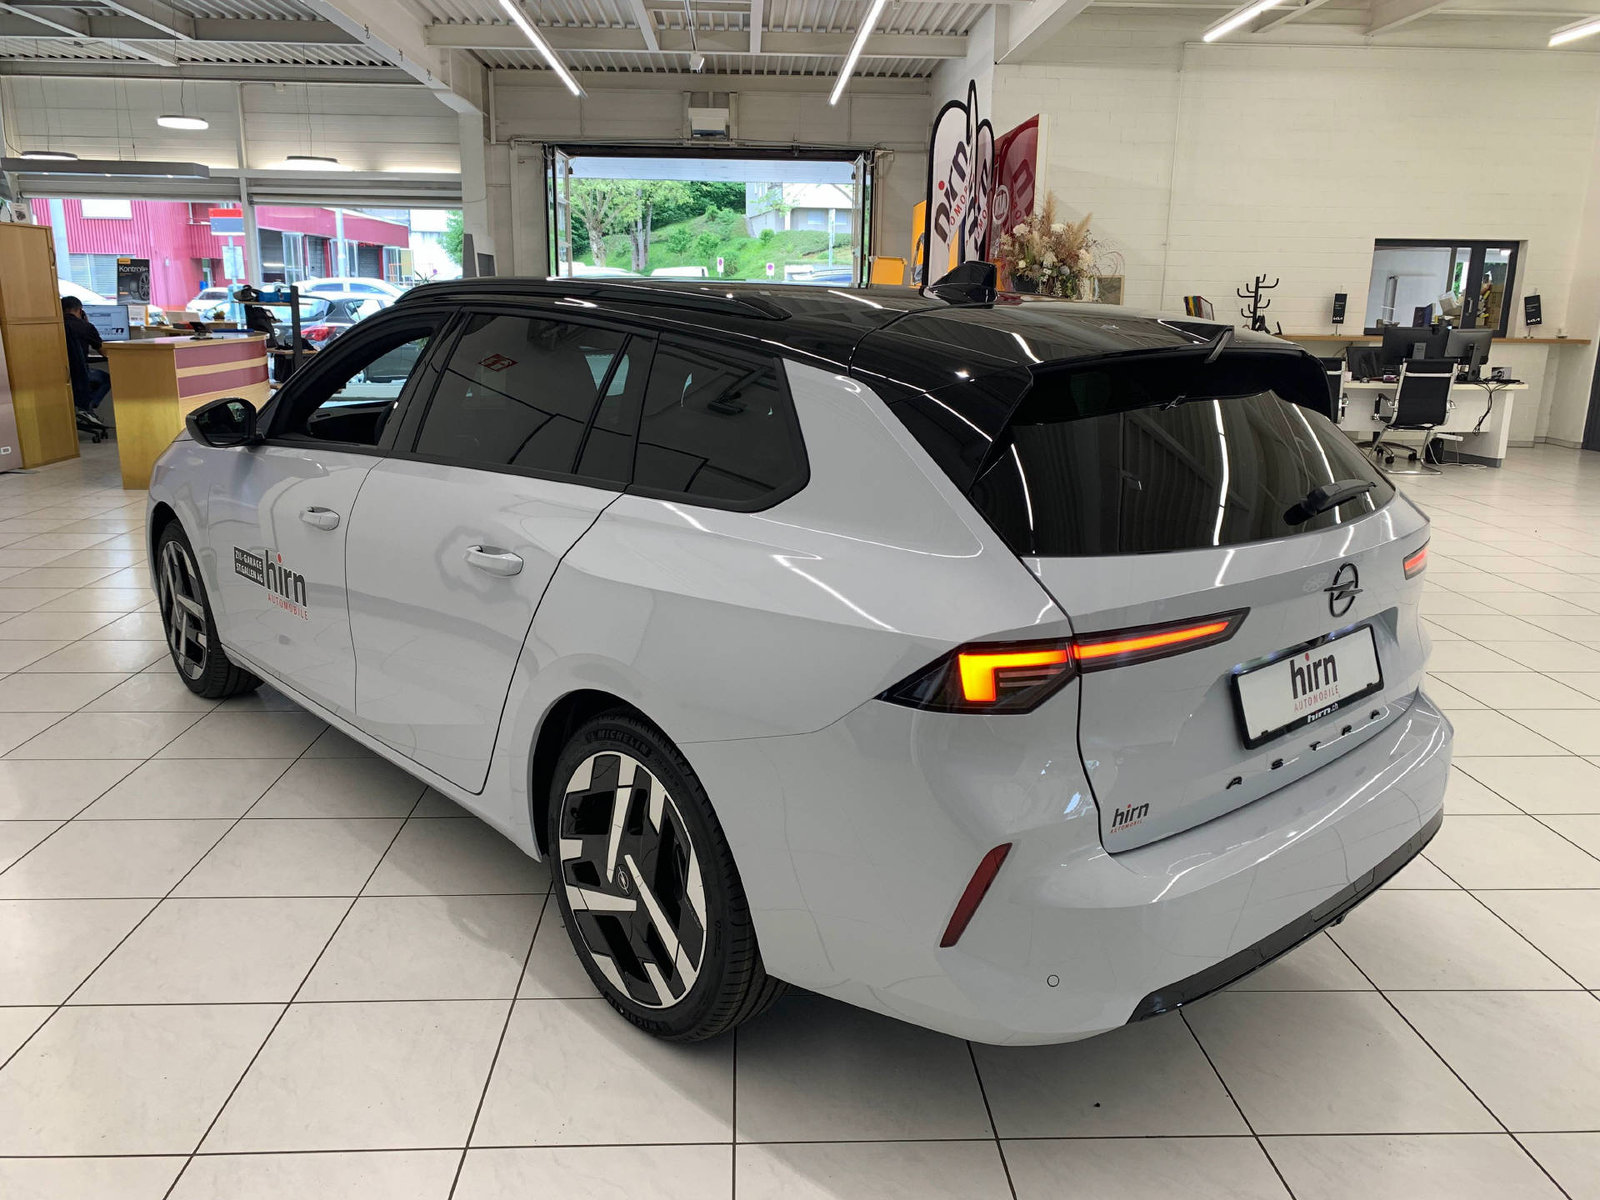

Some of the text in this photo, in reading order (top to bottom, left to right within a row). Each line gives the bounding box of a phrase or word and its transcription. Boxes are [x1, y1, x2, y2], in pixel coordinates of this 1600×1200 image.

[265, 549, 307, 607] hirn
[267, 593, 309, 620] AUTOMOBILE
[1289, 652, 1338, 700] hirn
[1294, 684, 1340, 713] AUTOMOBILE
[1307, 703, 1339, 723] hirn.ch
[597, 729, 650, 756] MICHELIN
[1226, 709, 1381, 790] ASTRA
[1112, 803, 1149, 828] hirn
